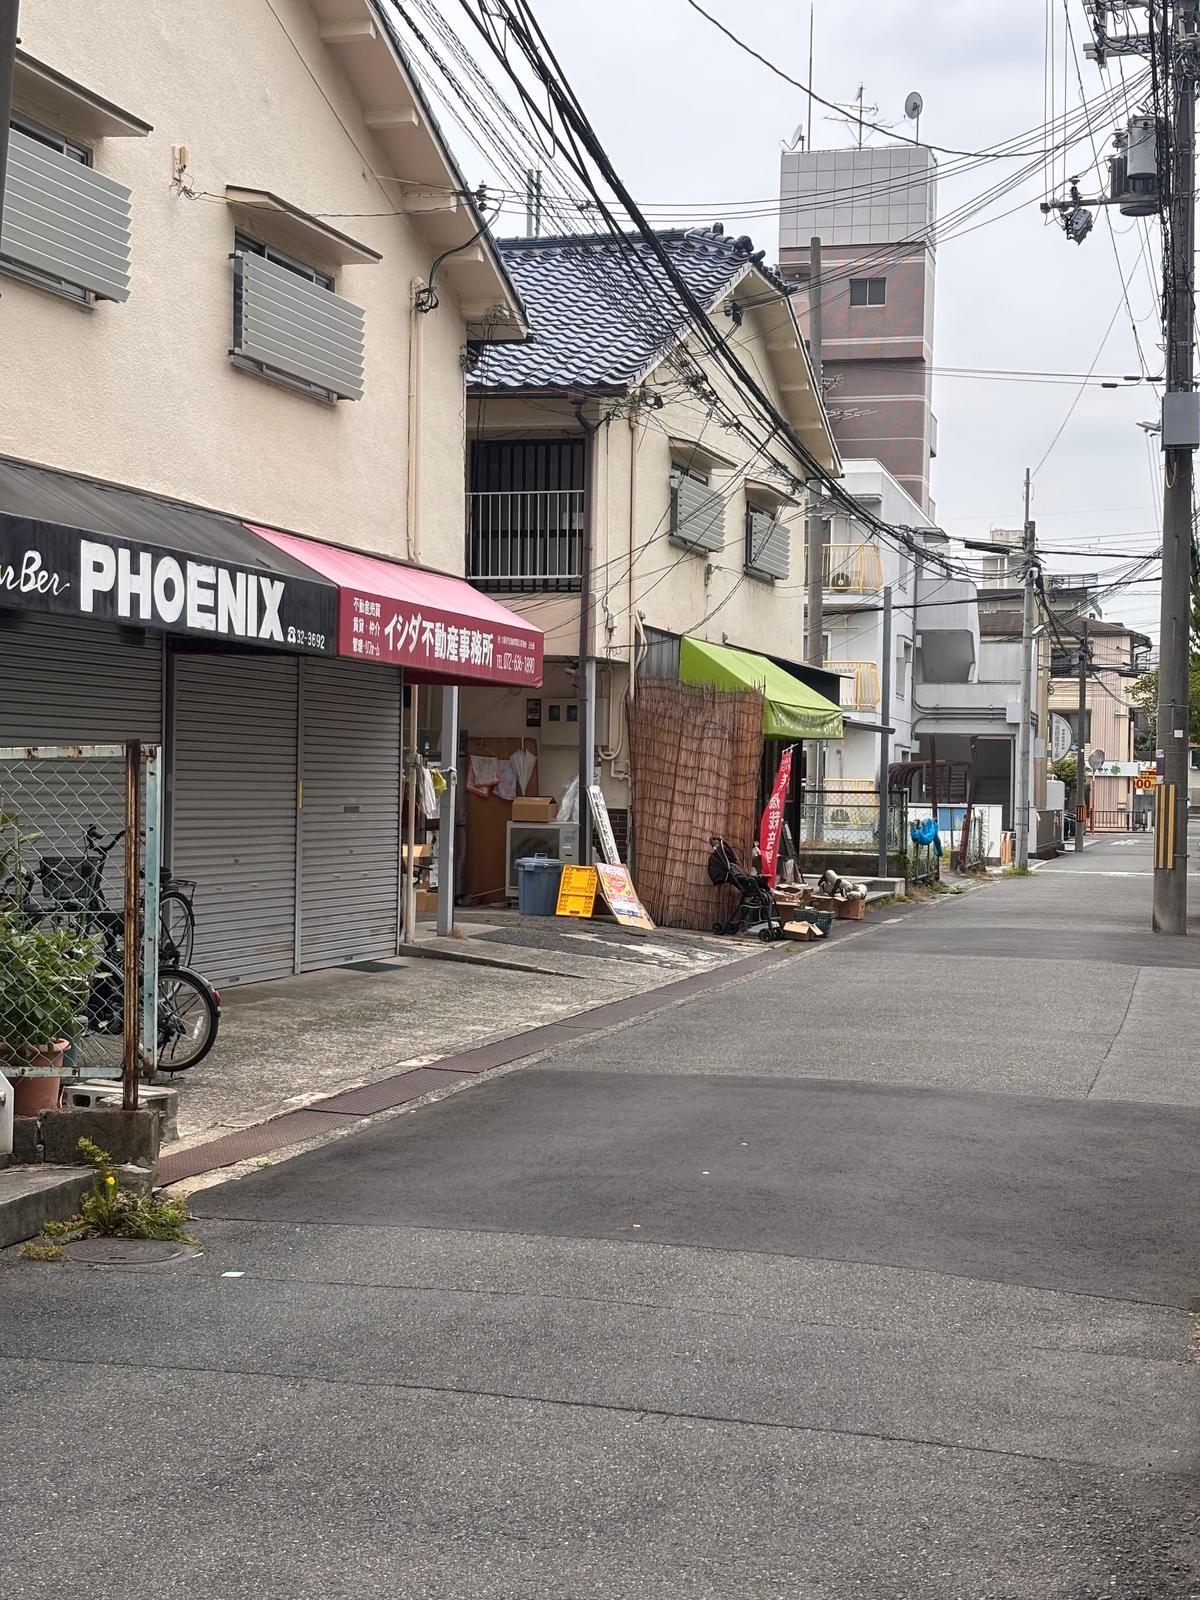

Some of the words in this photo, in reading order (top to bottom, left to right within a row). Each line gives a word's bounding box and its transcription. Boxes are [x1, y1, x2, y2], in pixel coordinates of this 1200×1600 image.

[79, 539, 286, 642] PHOENIX
[296, 629, 326, 650] 32-3692
[353, 596, 381, 618] 不動産売買
[384, 611, 494, 668] イシダ不動産事務所
